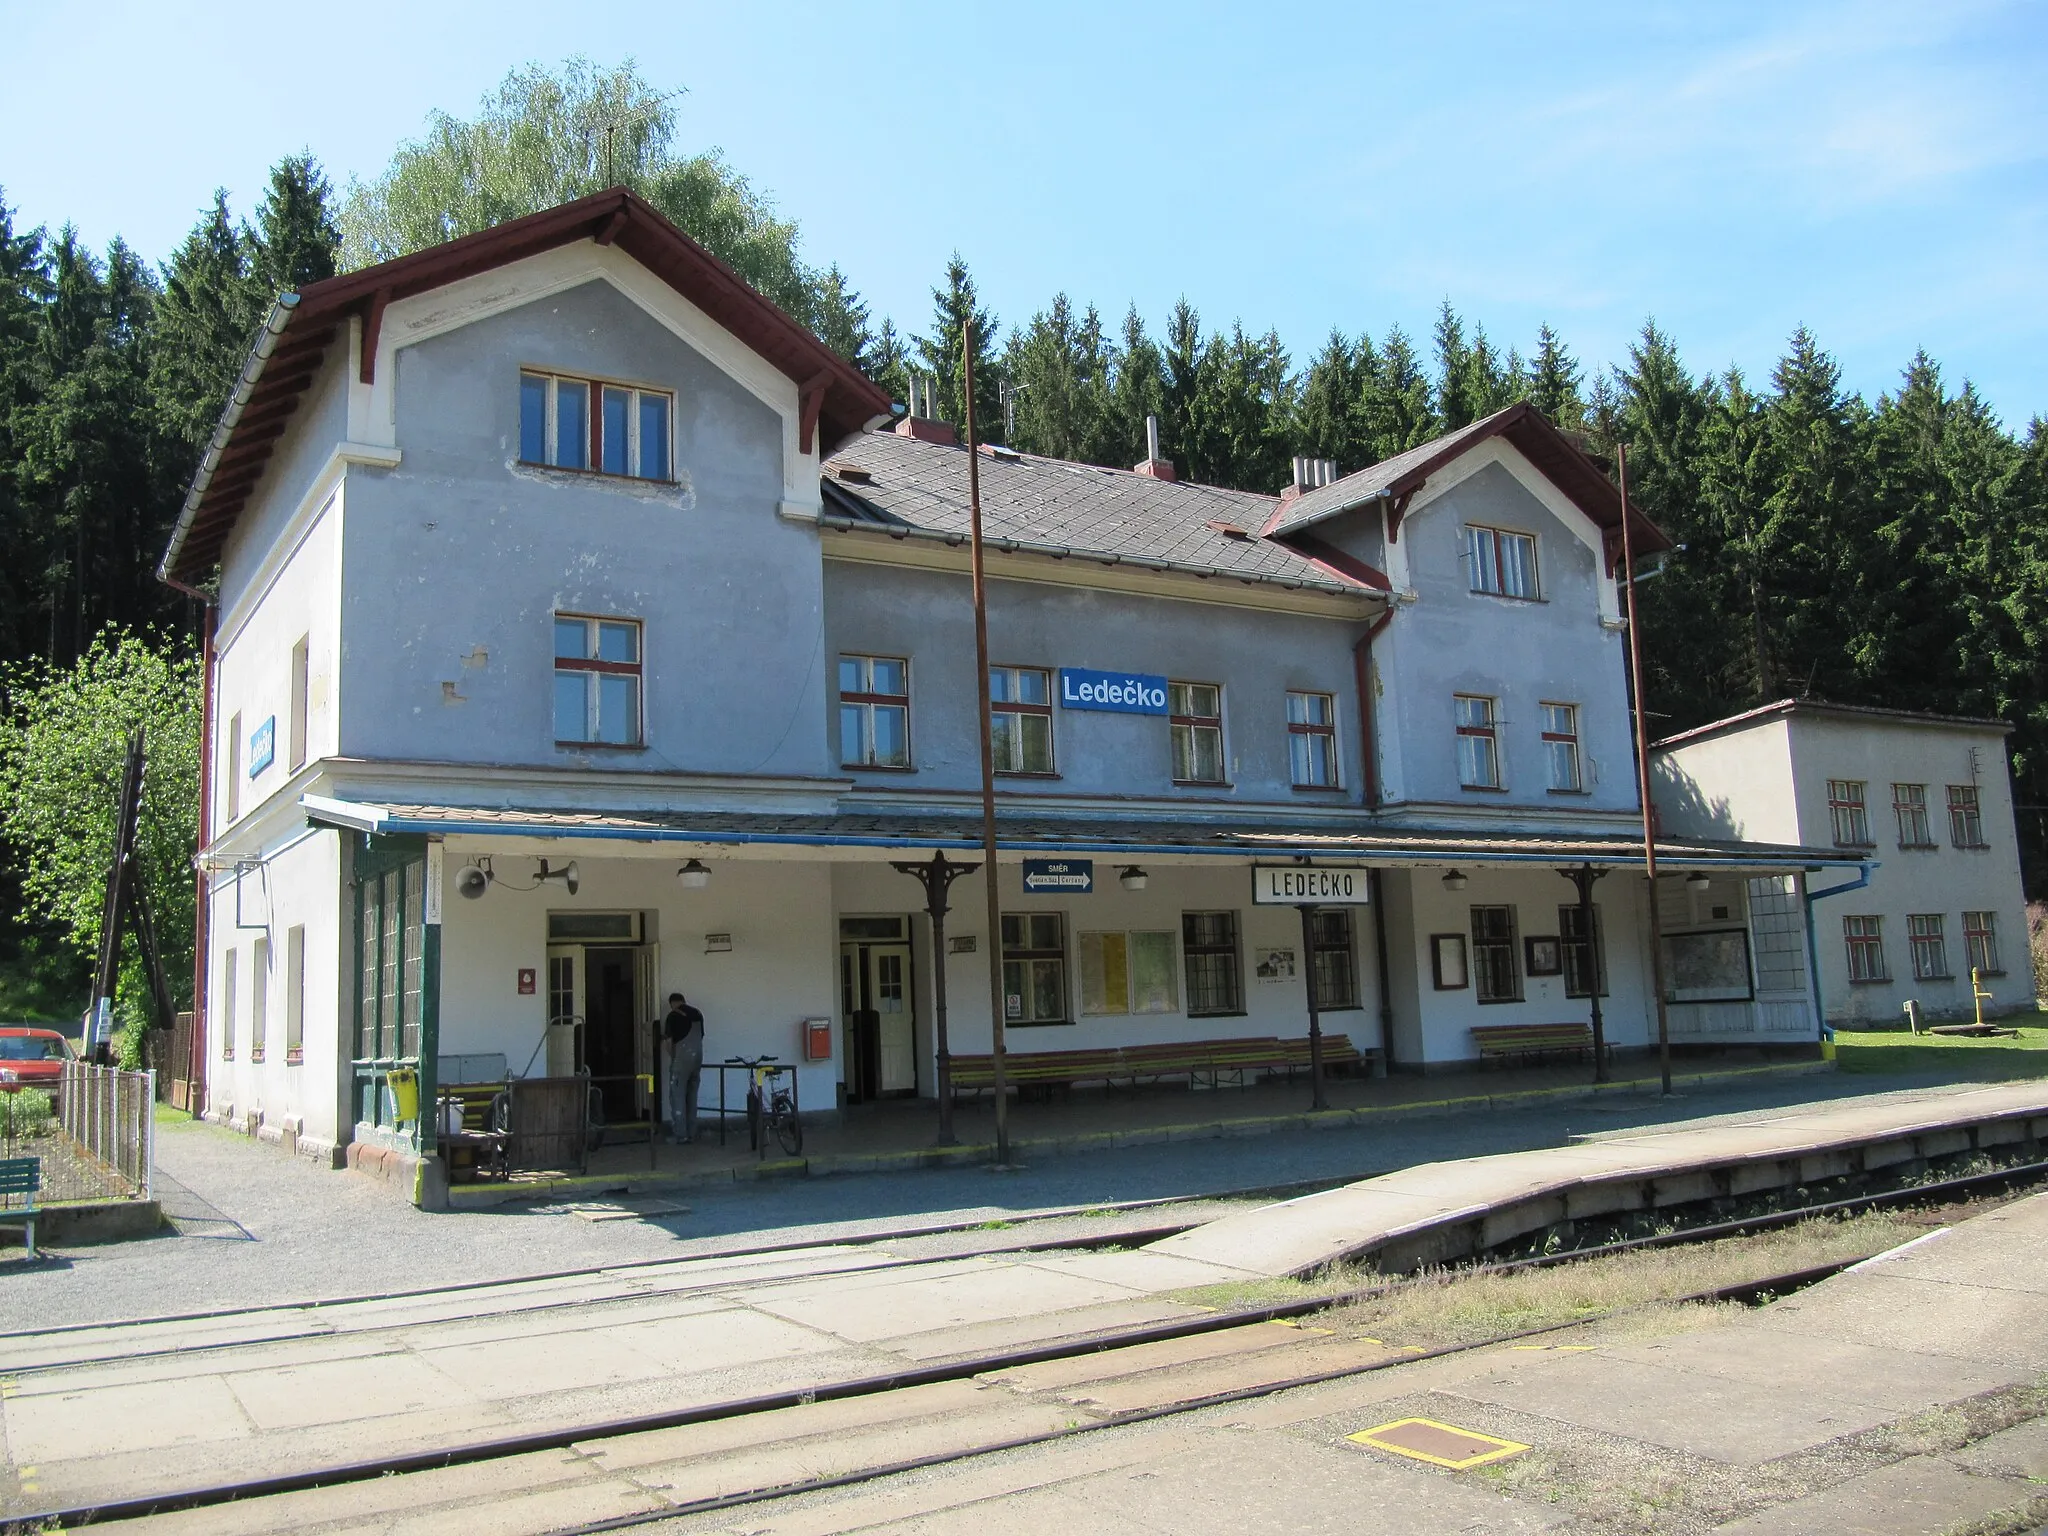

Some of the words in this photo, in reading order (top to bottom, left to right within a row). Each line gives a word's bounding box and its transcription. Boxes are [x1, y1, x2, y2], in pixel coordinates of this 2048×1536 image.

[1064, 676, 1166, 707] Ledečko
[1048, 863, 1068, 872] SMĚR
[1271, 870, 1353, 897] LEDEČKO
